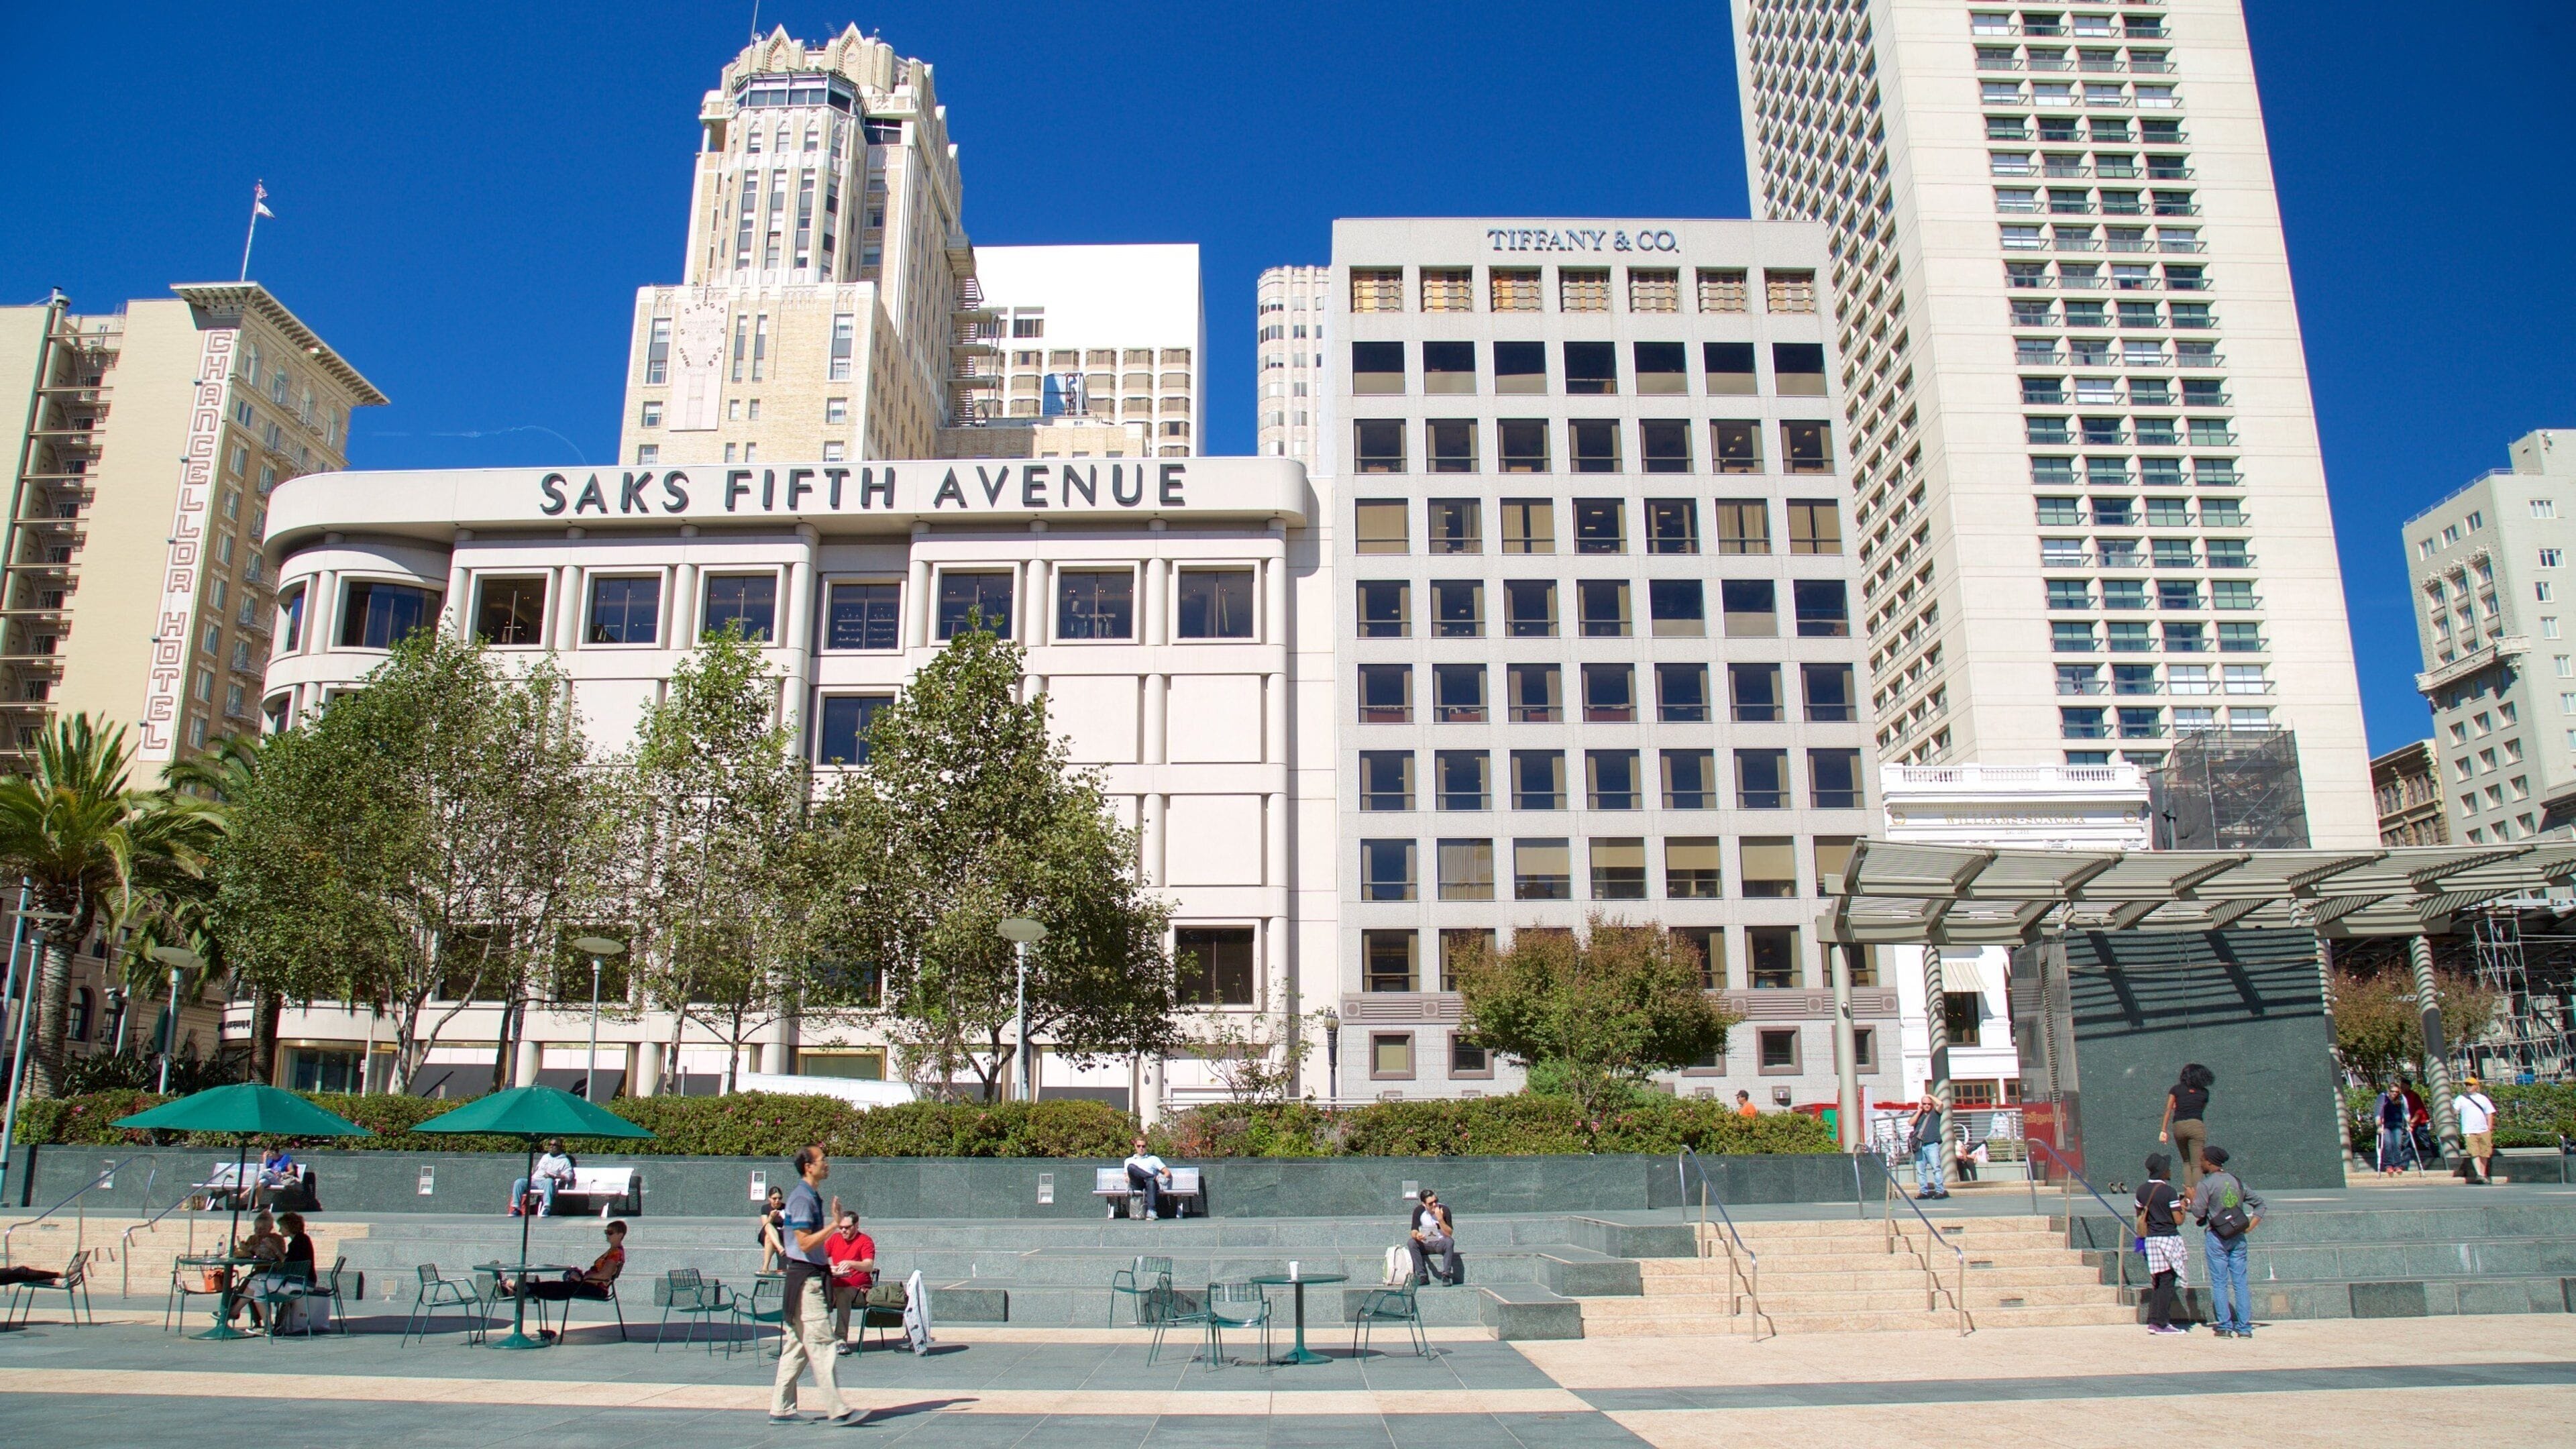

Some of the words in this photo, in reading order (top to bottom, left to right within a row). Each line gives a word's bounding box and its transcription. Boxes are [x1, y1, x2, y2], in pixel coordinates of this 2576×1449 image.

[1487, 229, 1607, 252] TIFFANY
[1613, 229, 1633, 252] &
[1636, 229, 1680, 254] CO.
[166, 331, 233, 593] CHANCELLOR
[539, 470, 690, 516] SAKS
[724, 467, 896, 512] FIFTH
[932, 463, 1187, 508] AVENUE
[144, 612, 186, 749] HOTEL
[1944, 814, 2086, 825] WILLIAMS-SONOMA
